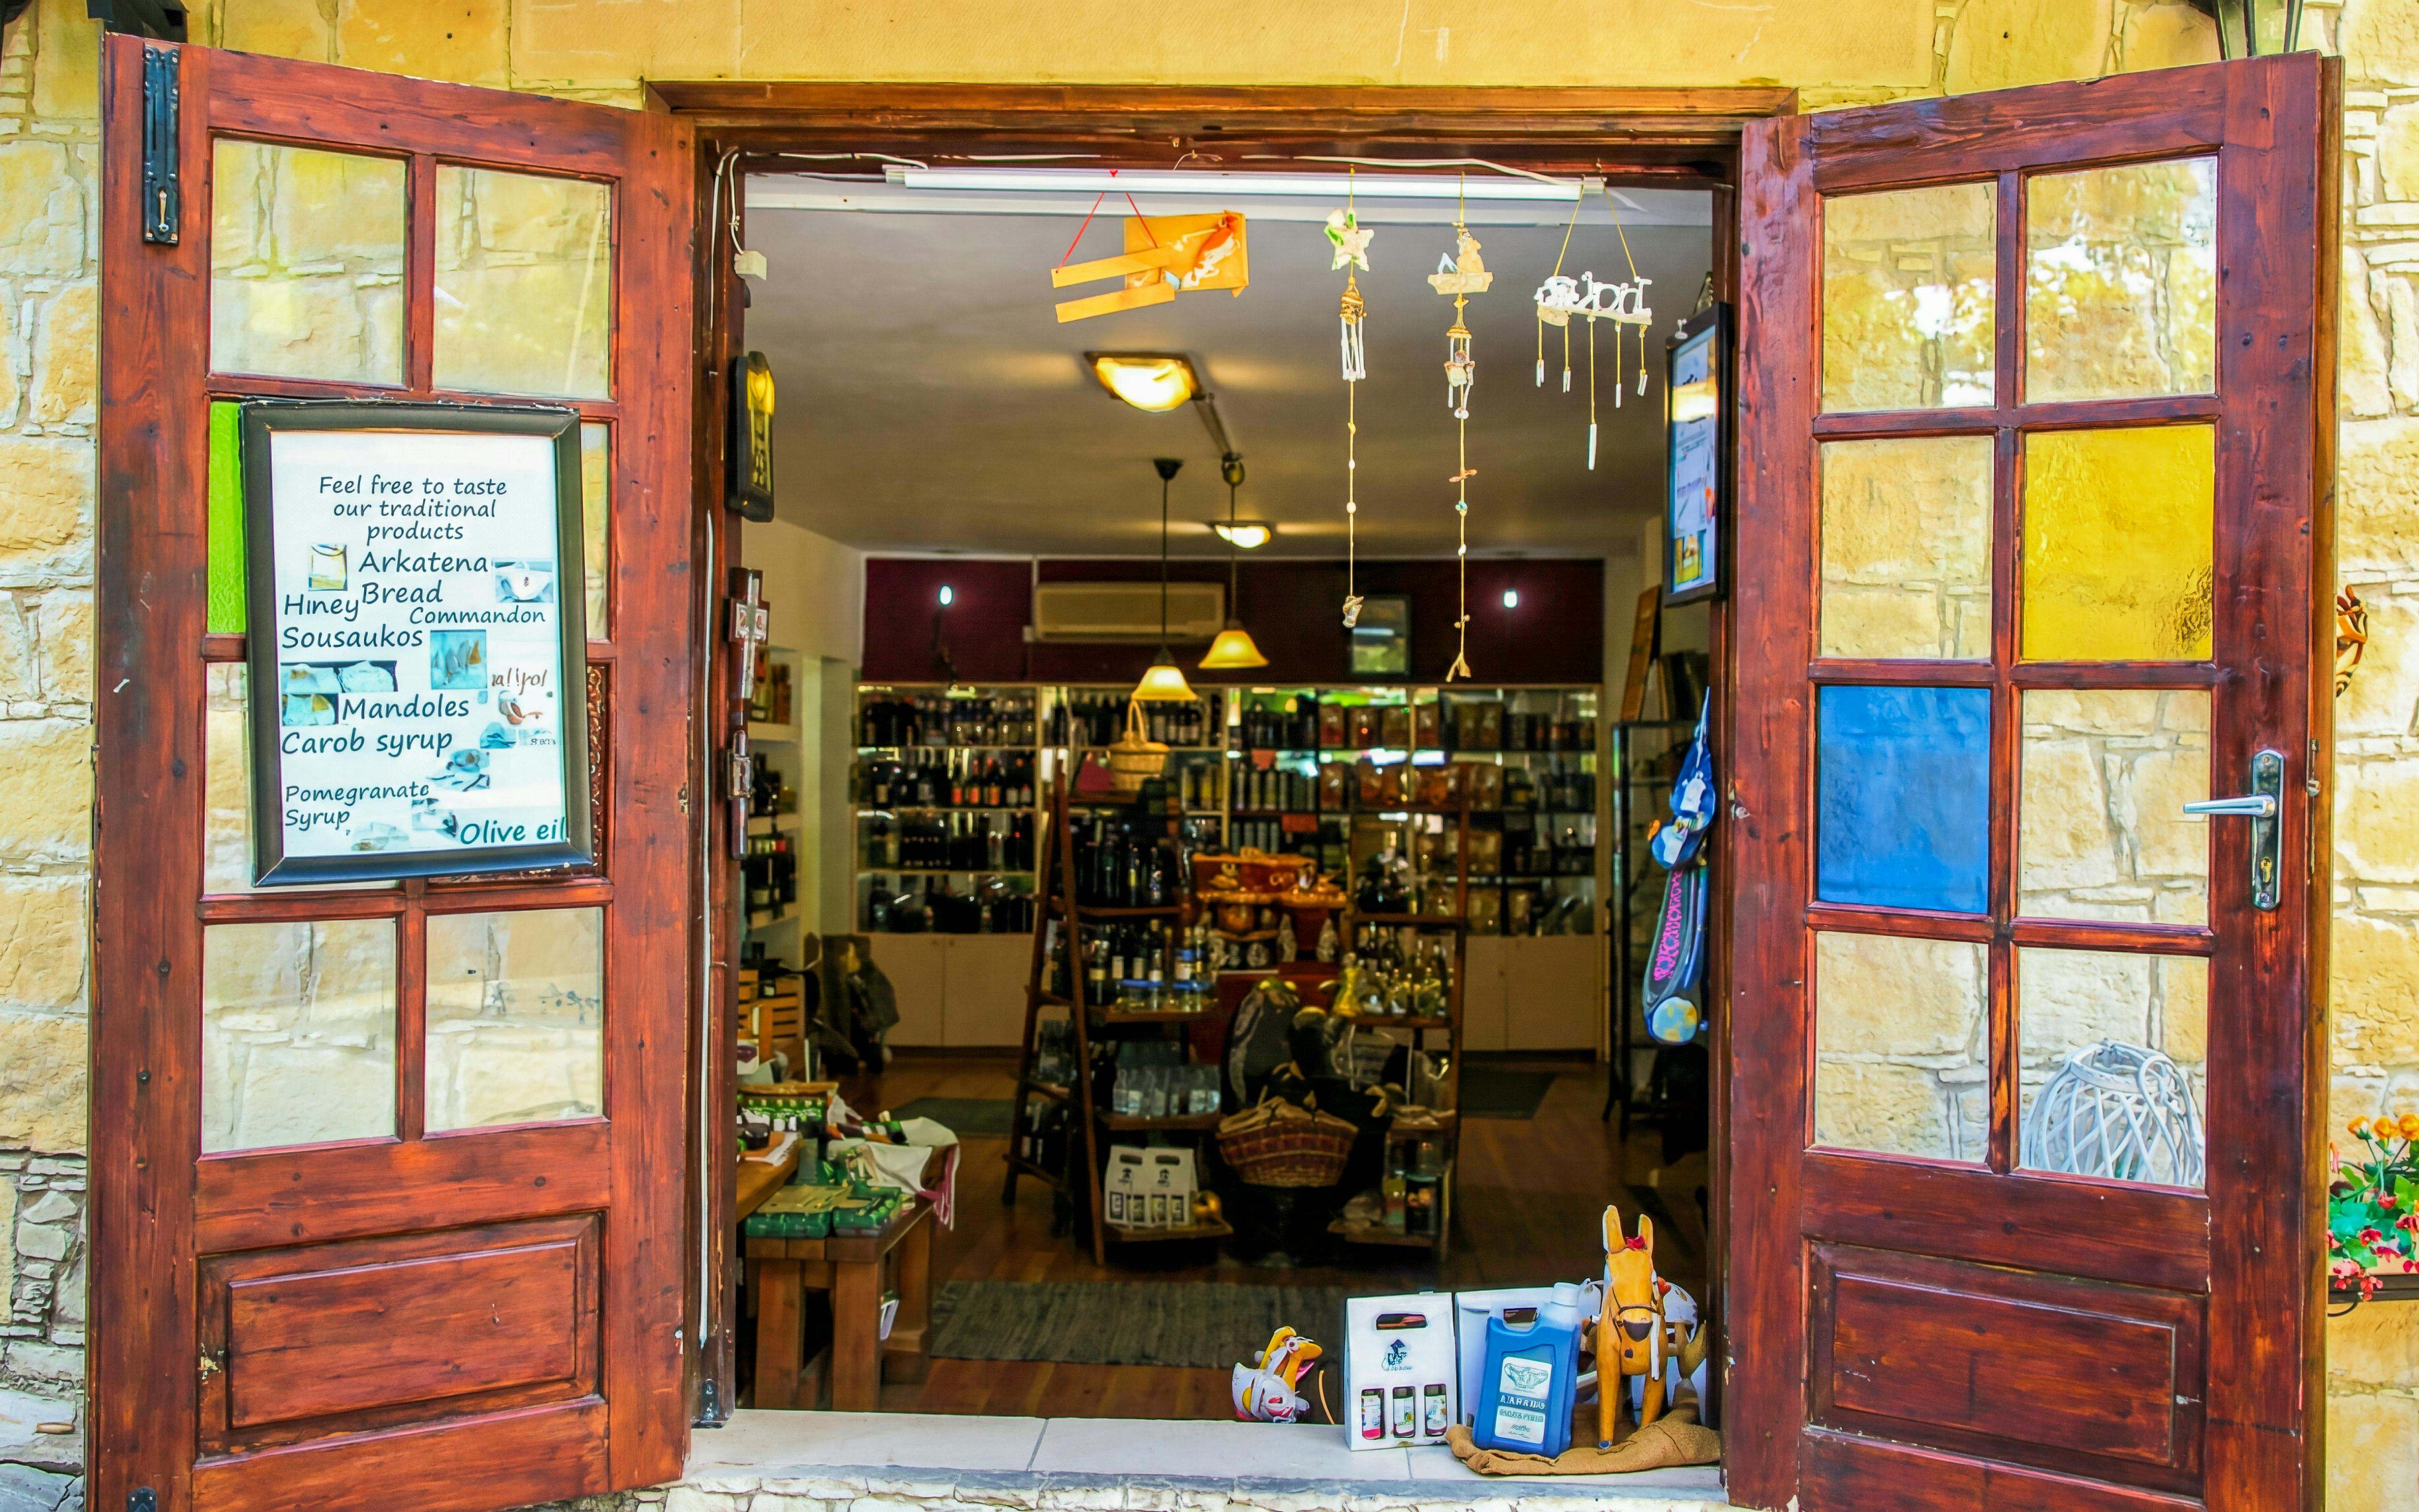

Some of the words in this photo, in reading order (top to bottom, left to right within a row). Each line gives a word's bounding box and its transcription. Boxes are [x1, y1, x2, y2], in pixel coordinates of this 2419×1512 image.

[319, 474, 362, 494] Feel
[371, 473, 413, 495] free
[422, 477, 444, 495] to
[453, 478, 507, 496] taste
[333, 504, 372, 517] our
[378, 498, 497, 518] traditional
[366, 520, 464, 547] products
[358, 548, 489, 573] Arkatena
[361, 579, 443, 605] Bread
[409, 604, 546, 625] Commandon
[283, 624, 423, 648] Sousaukos
[342, 694, 470, 721] Mandoles
[281, 728, 365, 755] Carob
[377, 733, 453, 757] syrup
[285, 809, 350, 832] Syrup
[460, 820, 526, 845] Olive
